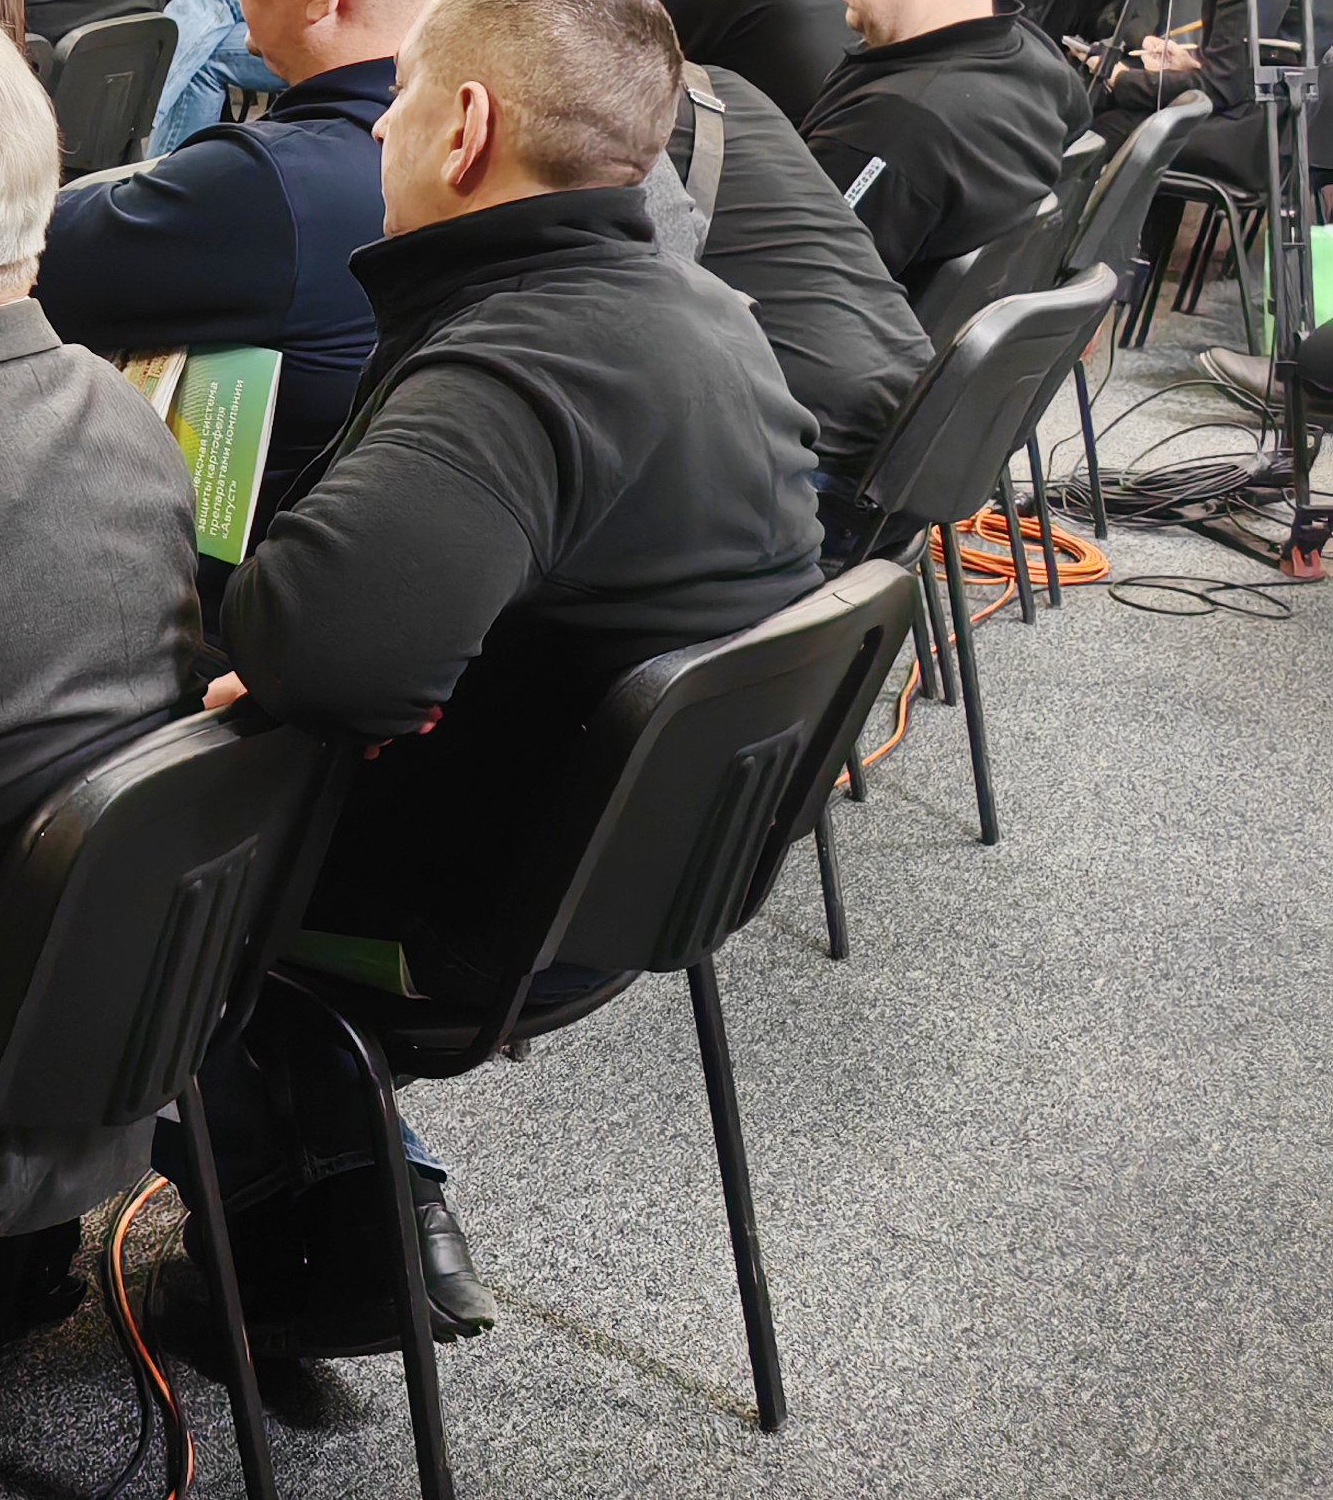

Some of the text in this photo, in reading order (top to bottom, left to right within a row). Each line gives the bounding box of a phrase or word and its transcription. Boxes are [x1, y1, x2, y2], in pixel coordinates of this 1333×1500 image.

[198, 407, 226, 532] защиты картофеля
[210, 379, 244, 536] препаратами компании
